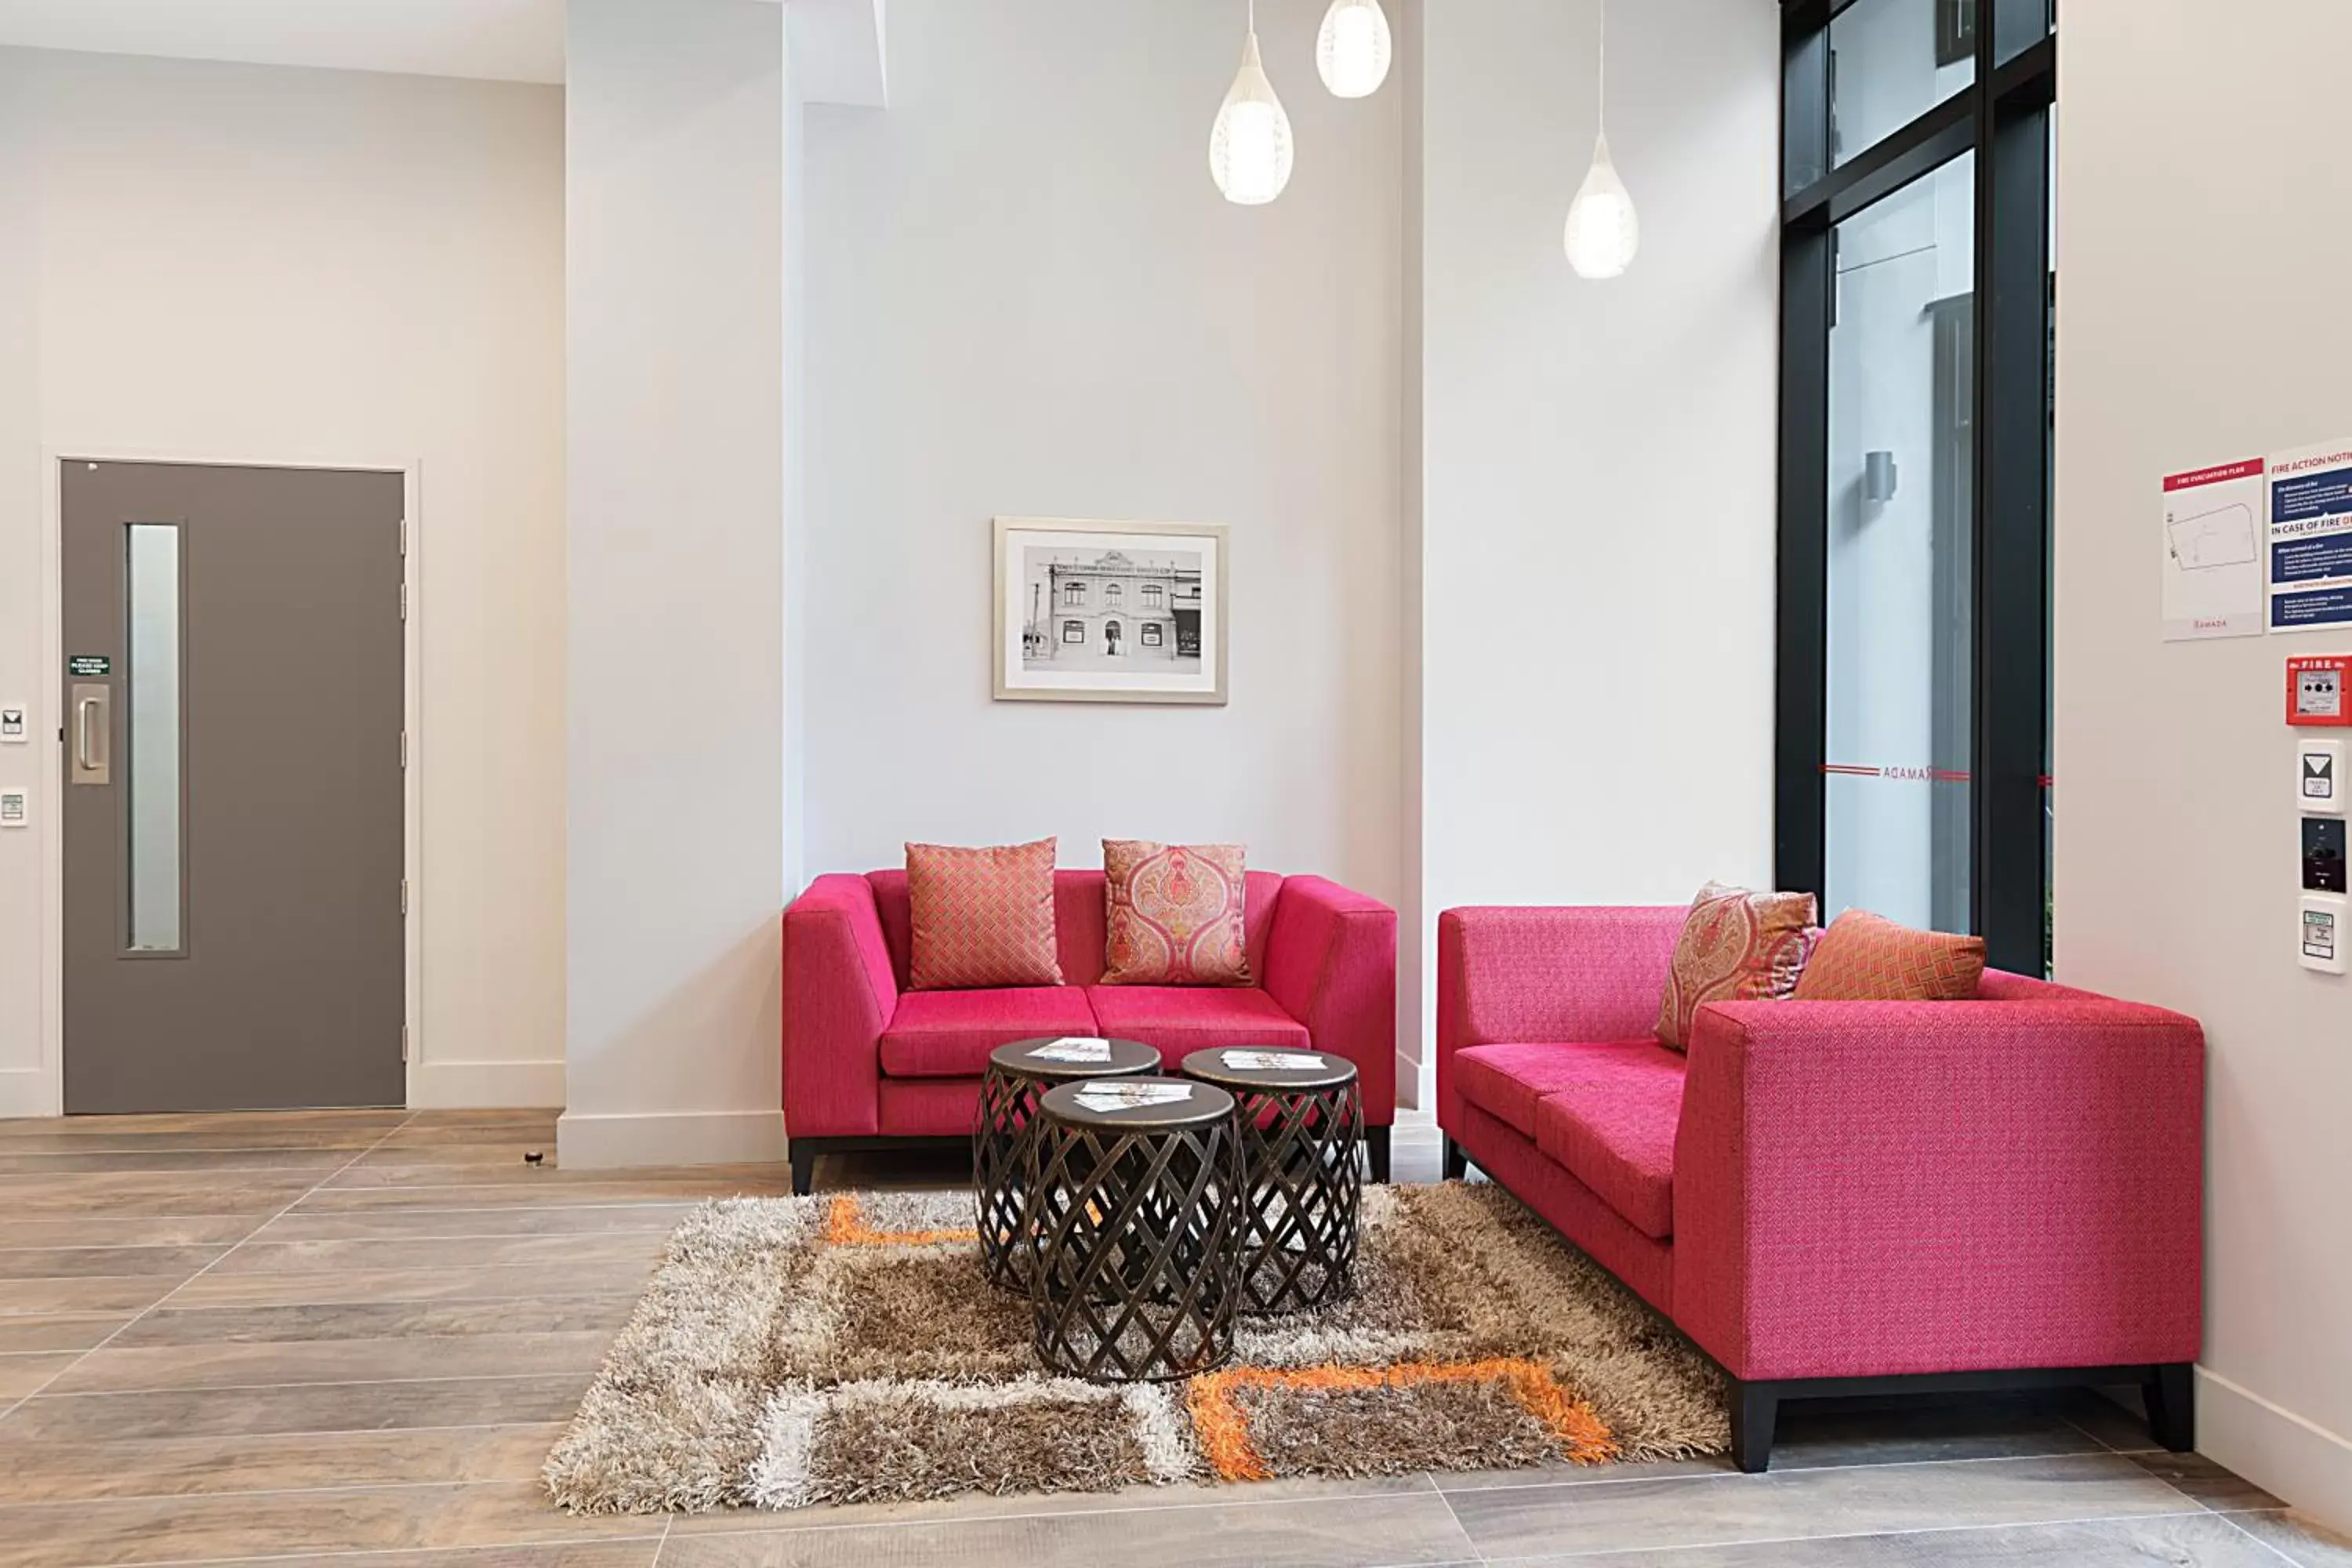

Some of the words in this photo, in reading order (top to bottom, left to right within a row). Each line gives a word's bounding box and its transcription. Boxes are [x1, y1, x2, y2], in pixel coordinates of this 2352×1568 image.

[2271, 463, 2290, 475] FIRE
[2292, 456, 2326, 471] ACTION
[2271, 526, 2281, 535] IN
[2282, 522, 2304, 534] CASE
[2306, 520, 2318, 530] OF
[2321, 517, 2341, 528] FIRE
[2301, 659, 2332, 670] FIRE
